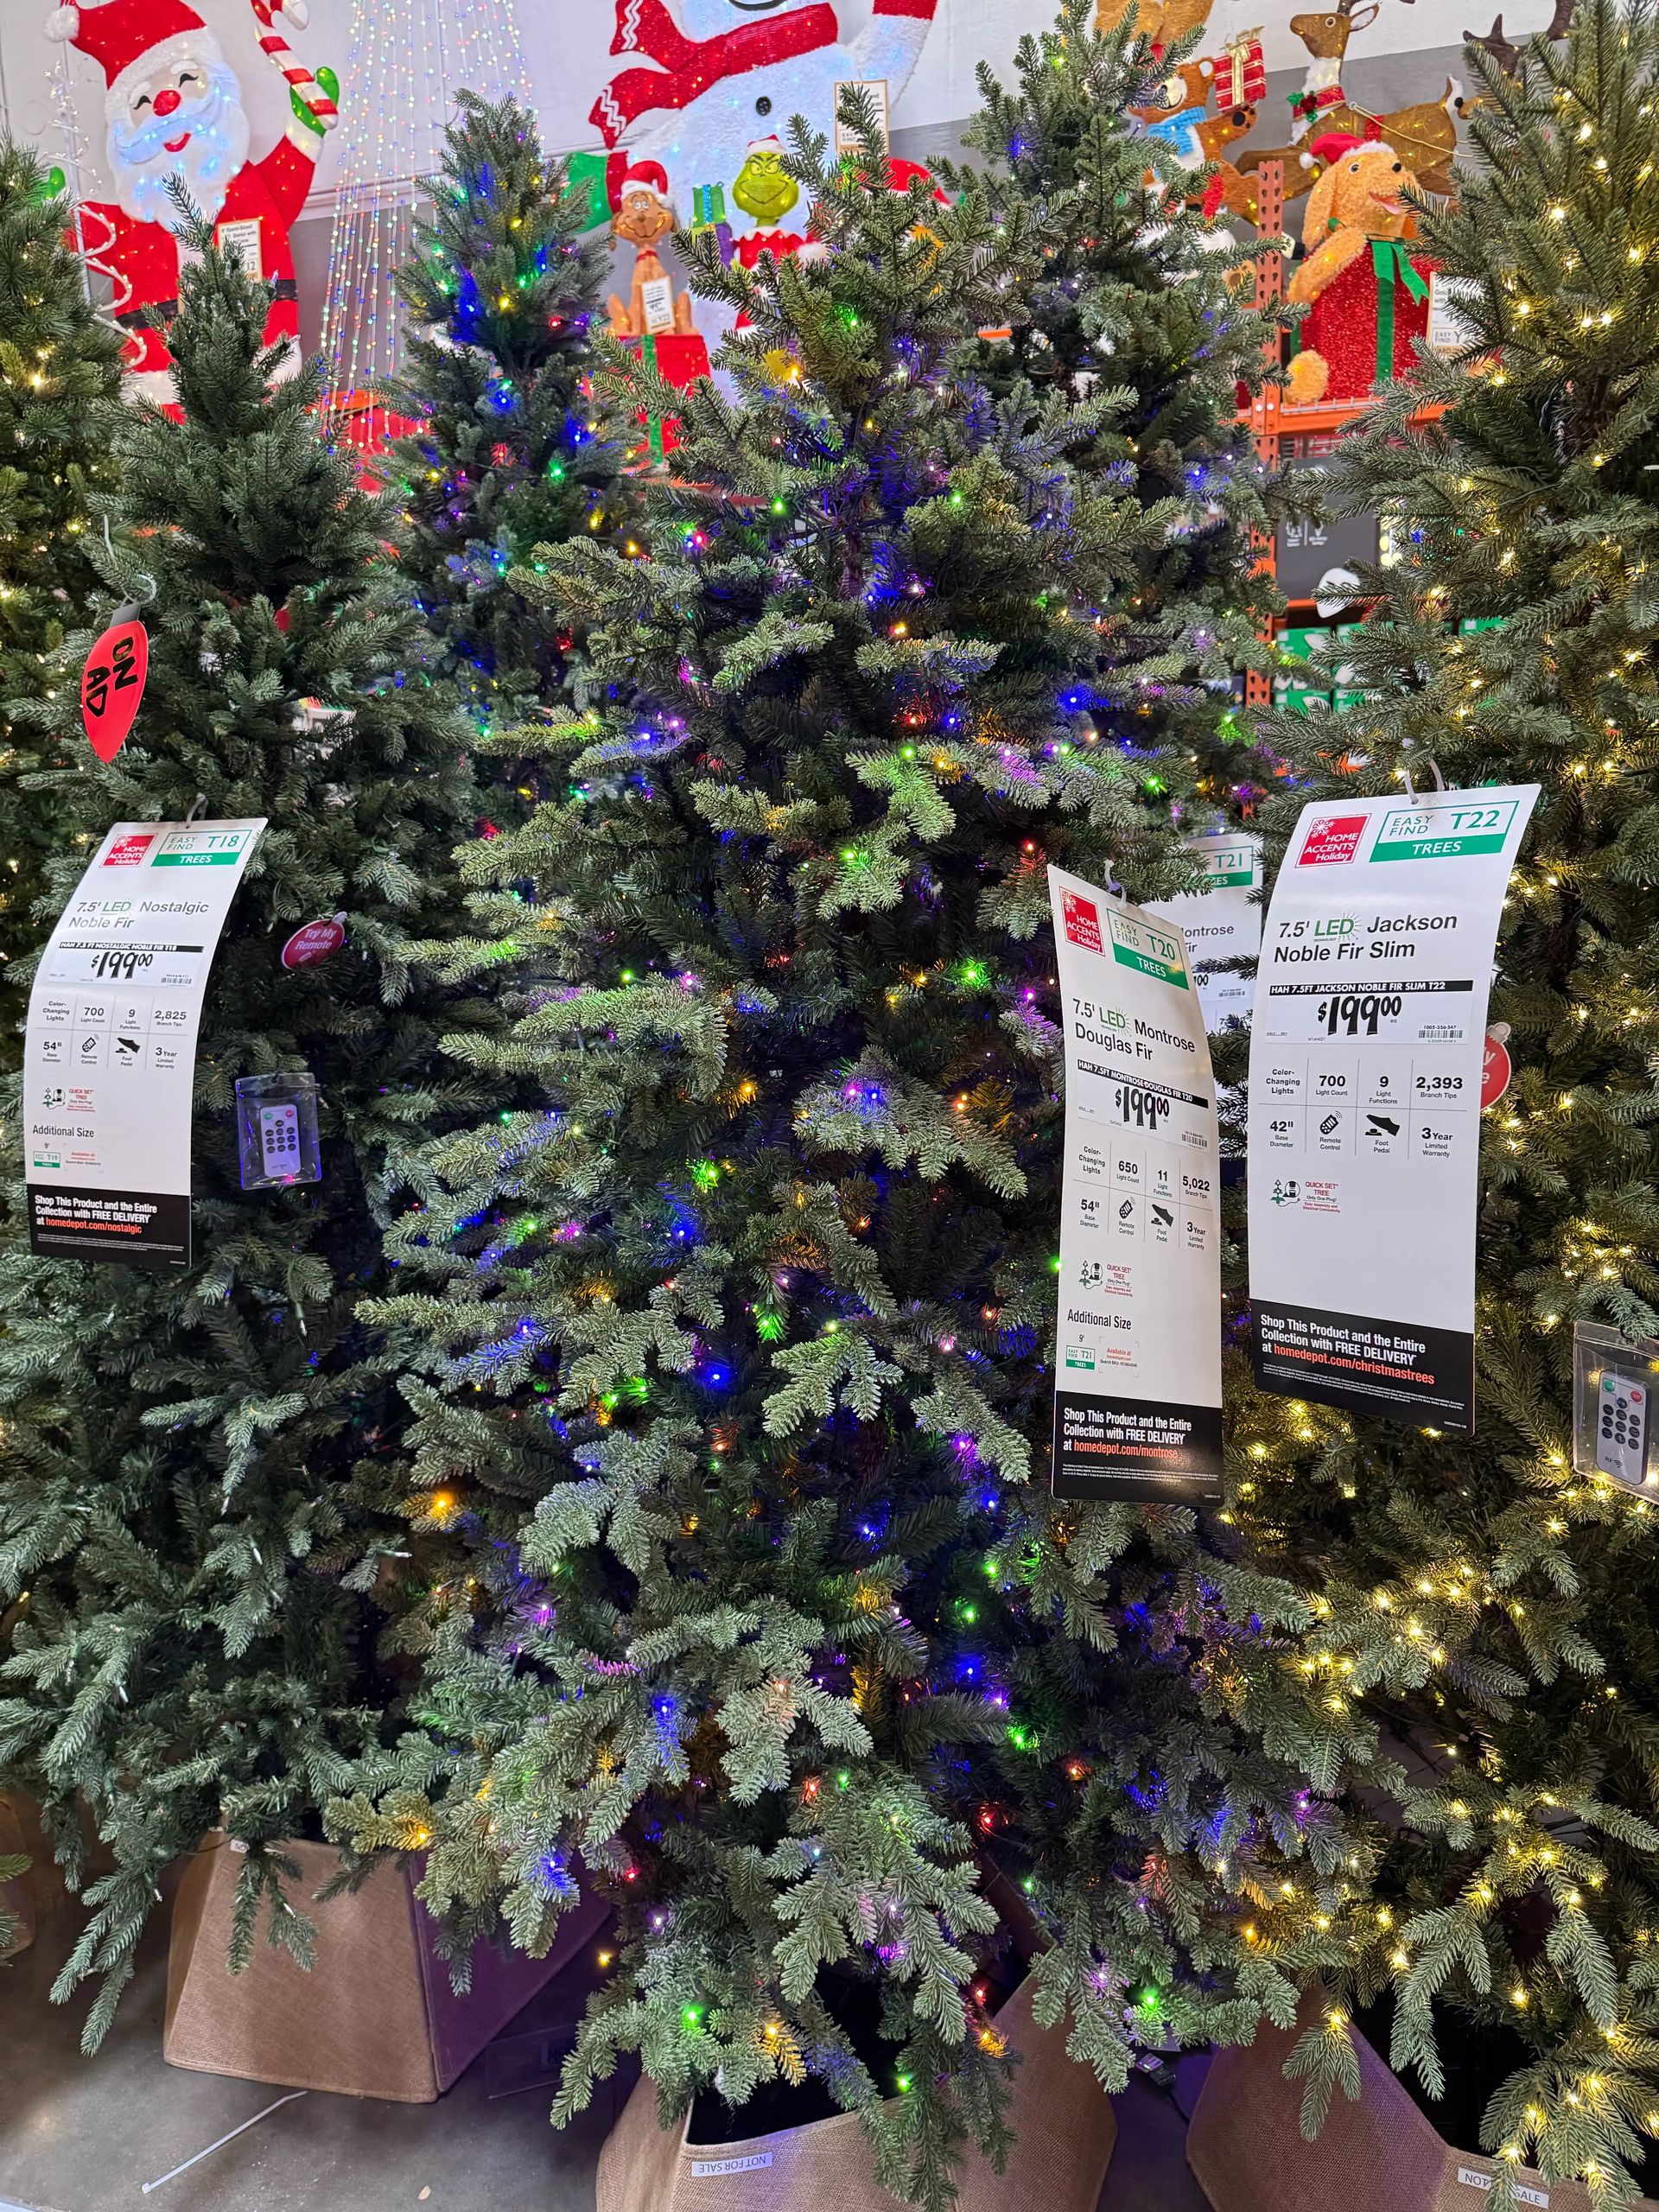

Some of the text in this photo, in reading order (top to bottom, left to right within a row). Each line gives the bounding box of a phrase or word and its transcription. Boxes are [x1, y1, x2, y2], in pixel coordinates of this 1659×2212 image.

[112, 636, 138, 690] ON
[86, 666, 111, 717] AD
[1393, 810, 1500, 830] EASY T22
[1325, 833, 1358, 842] HOME
[1389, 825, 1429, 836] FIND
[208, 836, 239, 848] T18
[1305, 842, 1355, 854] ACCENTS
[1412, 841, 1462, 855] TREES
[180, 855, 213, 864] TREES
[1214, 854, 1243, 868] T21
[1315, 852, 1351, 861] Holiday
[78, 901, 208, 915] 7.5' LED Nostalgic
[68, 918, 134, 928] Noble Fir
[1077, 915, 1098, 931] HOME
[1280, 914, 1457, 938] 7.5' LED Jackson
[305, 929, 337, 939] Try My
[1067, 923, 1100, 940] ACCENTS
[1117, 931, 1139, 946] FIND
[1181, 926, 1234, 937] ontrose
[295, 941, 332, 950] Remote
[1077, 933, 1101, 951] Holiday
[1115, 919, 1175, 961] EASY T20
[1274, 941, 1415, 963] Noble Fir Slim
[1136, 957, 1166, 977] TREES
[1428, 982, 1445, 990] T22
[85, 1007, 104, 1016] 700
[155, 1011, 187, 1020] 2,825
[1073, 998, 1195, 1052] 7.5' LED Montrose
[1076, 1022, 1153, 1060] Douglas Fir
[1079, 1061, 1192, 1102] HAH 7.5FT MONTROSE DOUGLAS FIR T20
[1266, 1077, 1300, 1086] Changing
[1319, 1075, 1345, 1087] 700
[1379, 1076, 1389, 1087] 9
[1416, 1077, 1463, 1091] 2,393
[33, 1125, 94, 1138] Additional Size
[1421, 1128, 1431, 1140] 3
[1084, 1147, 1101, 1155] Color-
[1079, 1154, 1105, 1166] Changing
[1119, 1160, 1138, 1174] 650
[1083, 1165, 1100, 1174] Lights
[1158, 1170, 1167, 1181] 11
[1183, 1176, 1210, 1192] 5,022
[35, 1195, 157, 1213] Shop This Product and the Entire
[35, 1205, 73, 1217] Collection
[73, 1209, 91, 1219] with
[92, 1211, 111, 1221] FREE
[46, 1217, 142, 1235] homedepot.com/nostalgic
[1187, 1222, 1205, 1236] 3 Year
[1068, 1309, 1131, 1330] Additional Size
[1261, 1314, 1426, 1354] Shop This Product and the Entire
[1262, 1327, 1308, 1346] Collection
[1311, 1338, 1332, 1351] with
[1335, 1342, 1361, 1357] FREE
[1262, 1342, 1272, 1354] at
[1274, 1343, 1435, 1385] homedepot.com/christmastrees
[1065, 1408, 1192, 1432] Shop This Product and the Entire
[1064, 1423, 1104, 1439] Collection
[1106, 1427, 1123, 1441] with
[1126, 1428, 1146, 1442] FREE
[1063, 1440, 1179, 1459] at homedepot.com/montrose
[699, 2155, 766, 2173] NOT FOR SALE
